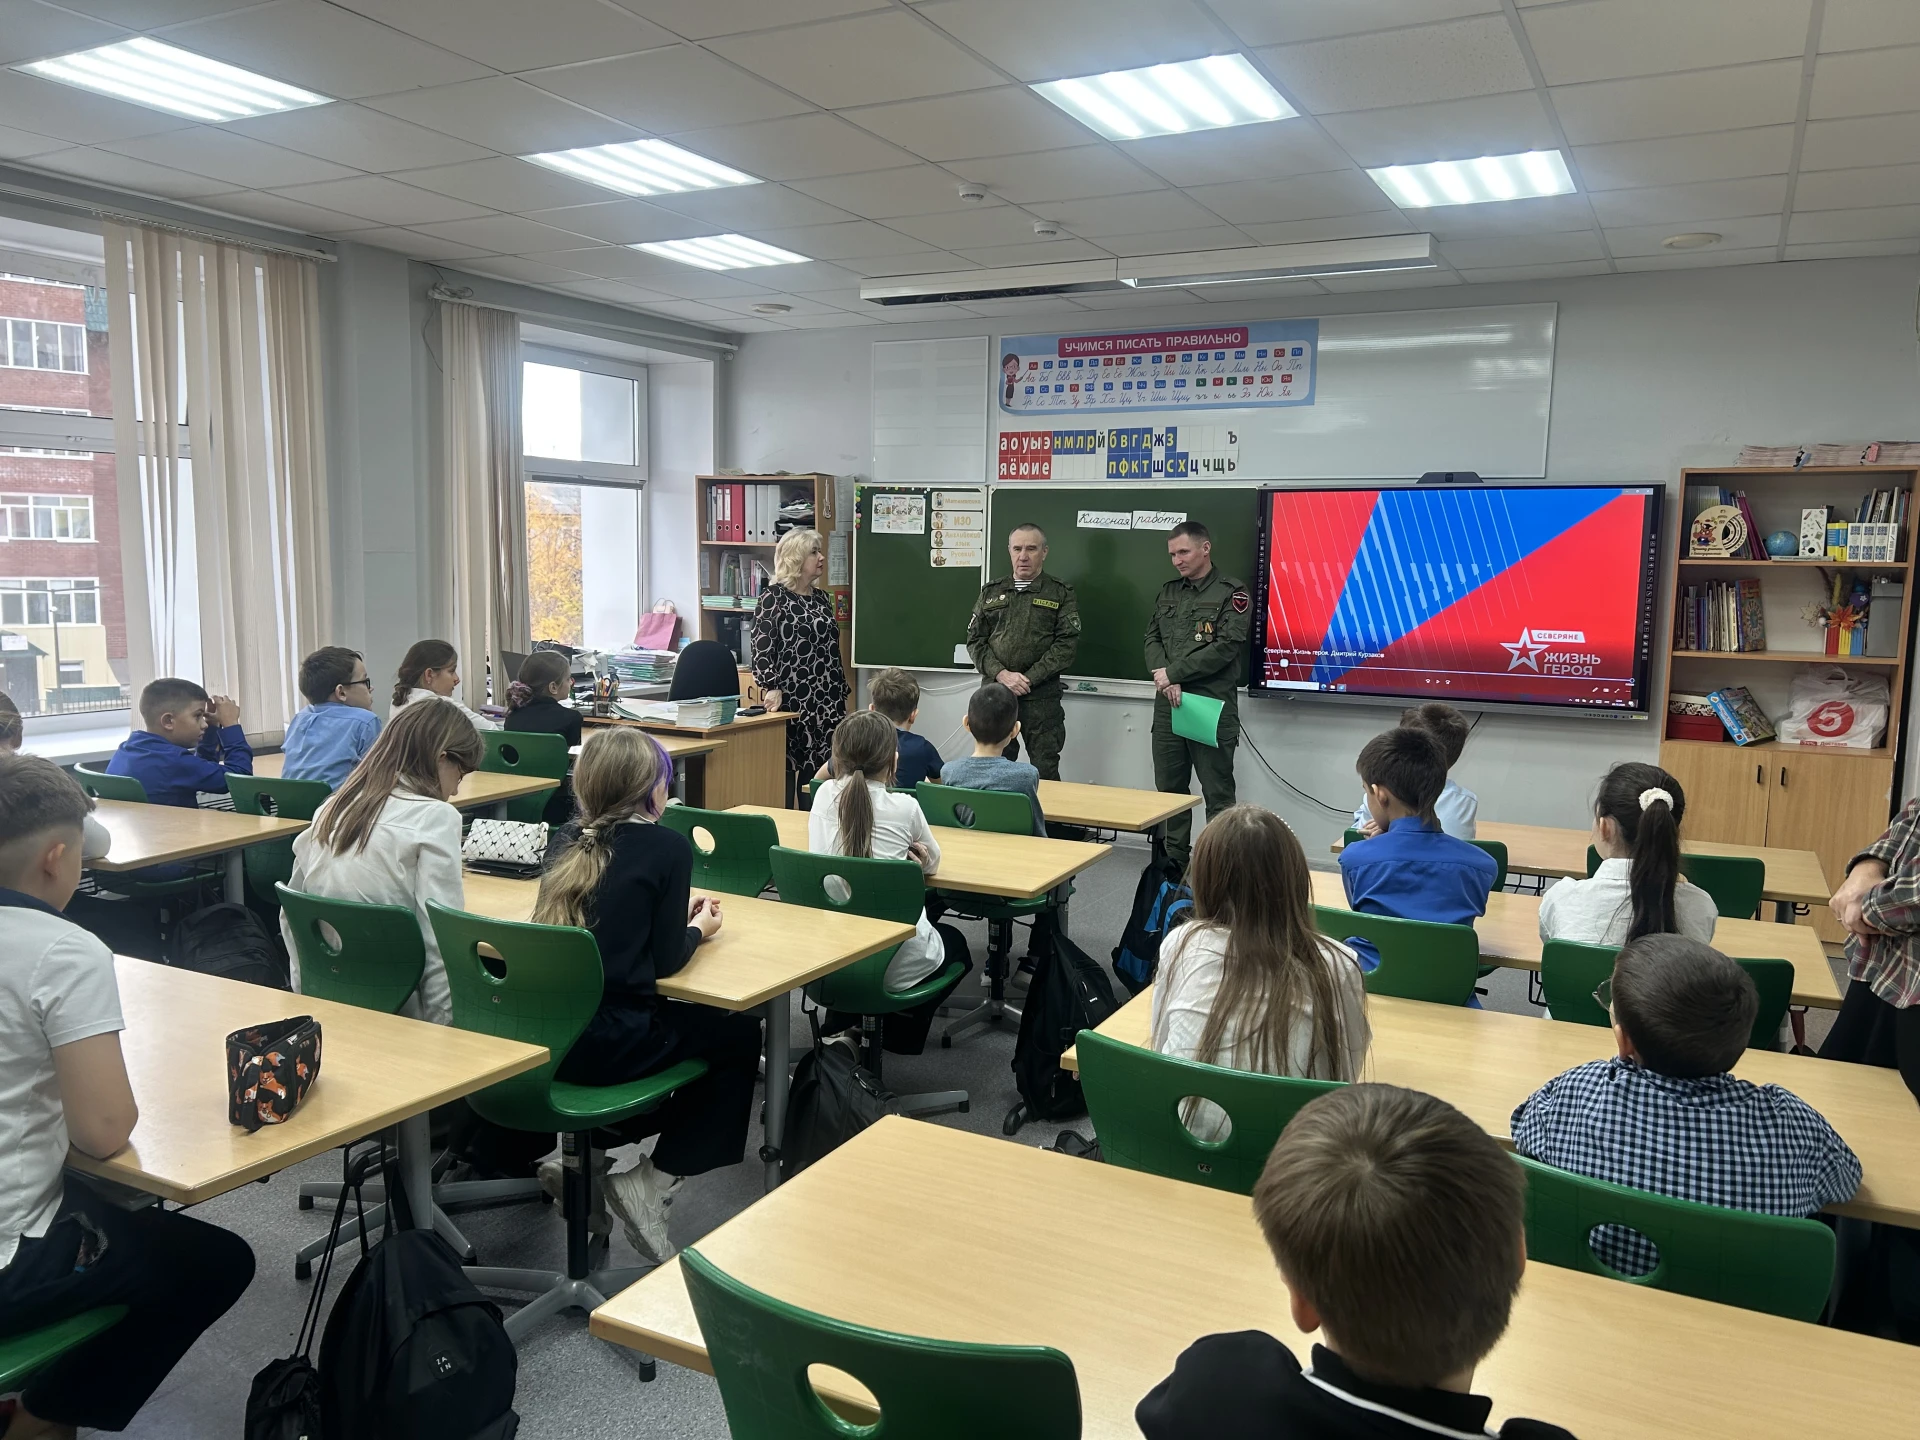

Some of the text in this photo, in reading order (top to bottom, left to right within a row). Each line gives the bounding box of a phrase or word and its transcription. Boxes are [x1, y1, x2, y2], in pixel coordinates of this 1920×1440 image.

[1065, 333, 1240, 352] УЧИМСЯ ПИСАТЬ ПРАВИЛЬНО
[954, 516, 971, 526] ИЗО
[1078, 513, 1130, 526] Классная
[1331, 650, 1356, 658] Дмитрий
[1544, 652, 1601, 664] ЖИЗНЬ
[1544, 664, 1592, 676] ГЕРОЯ
[436, 1356, 447, 1365] ZA
[440, 1363, 451, 1373] IN
